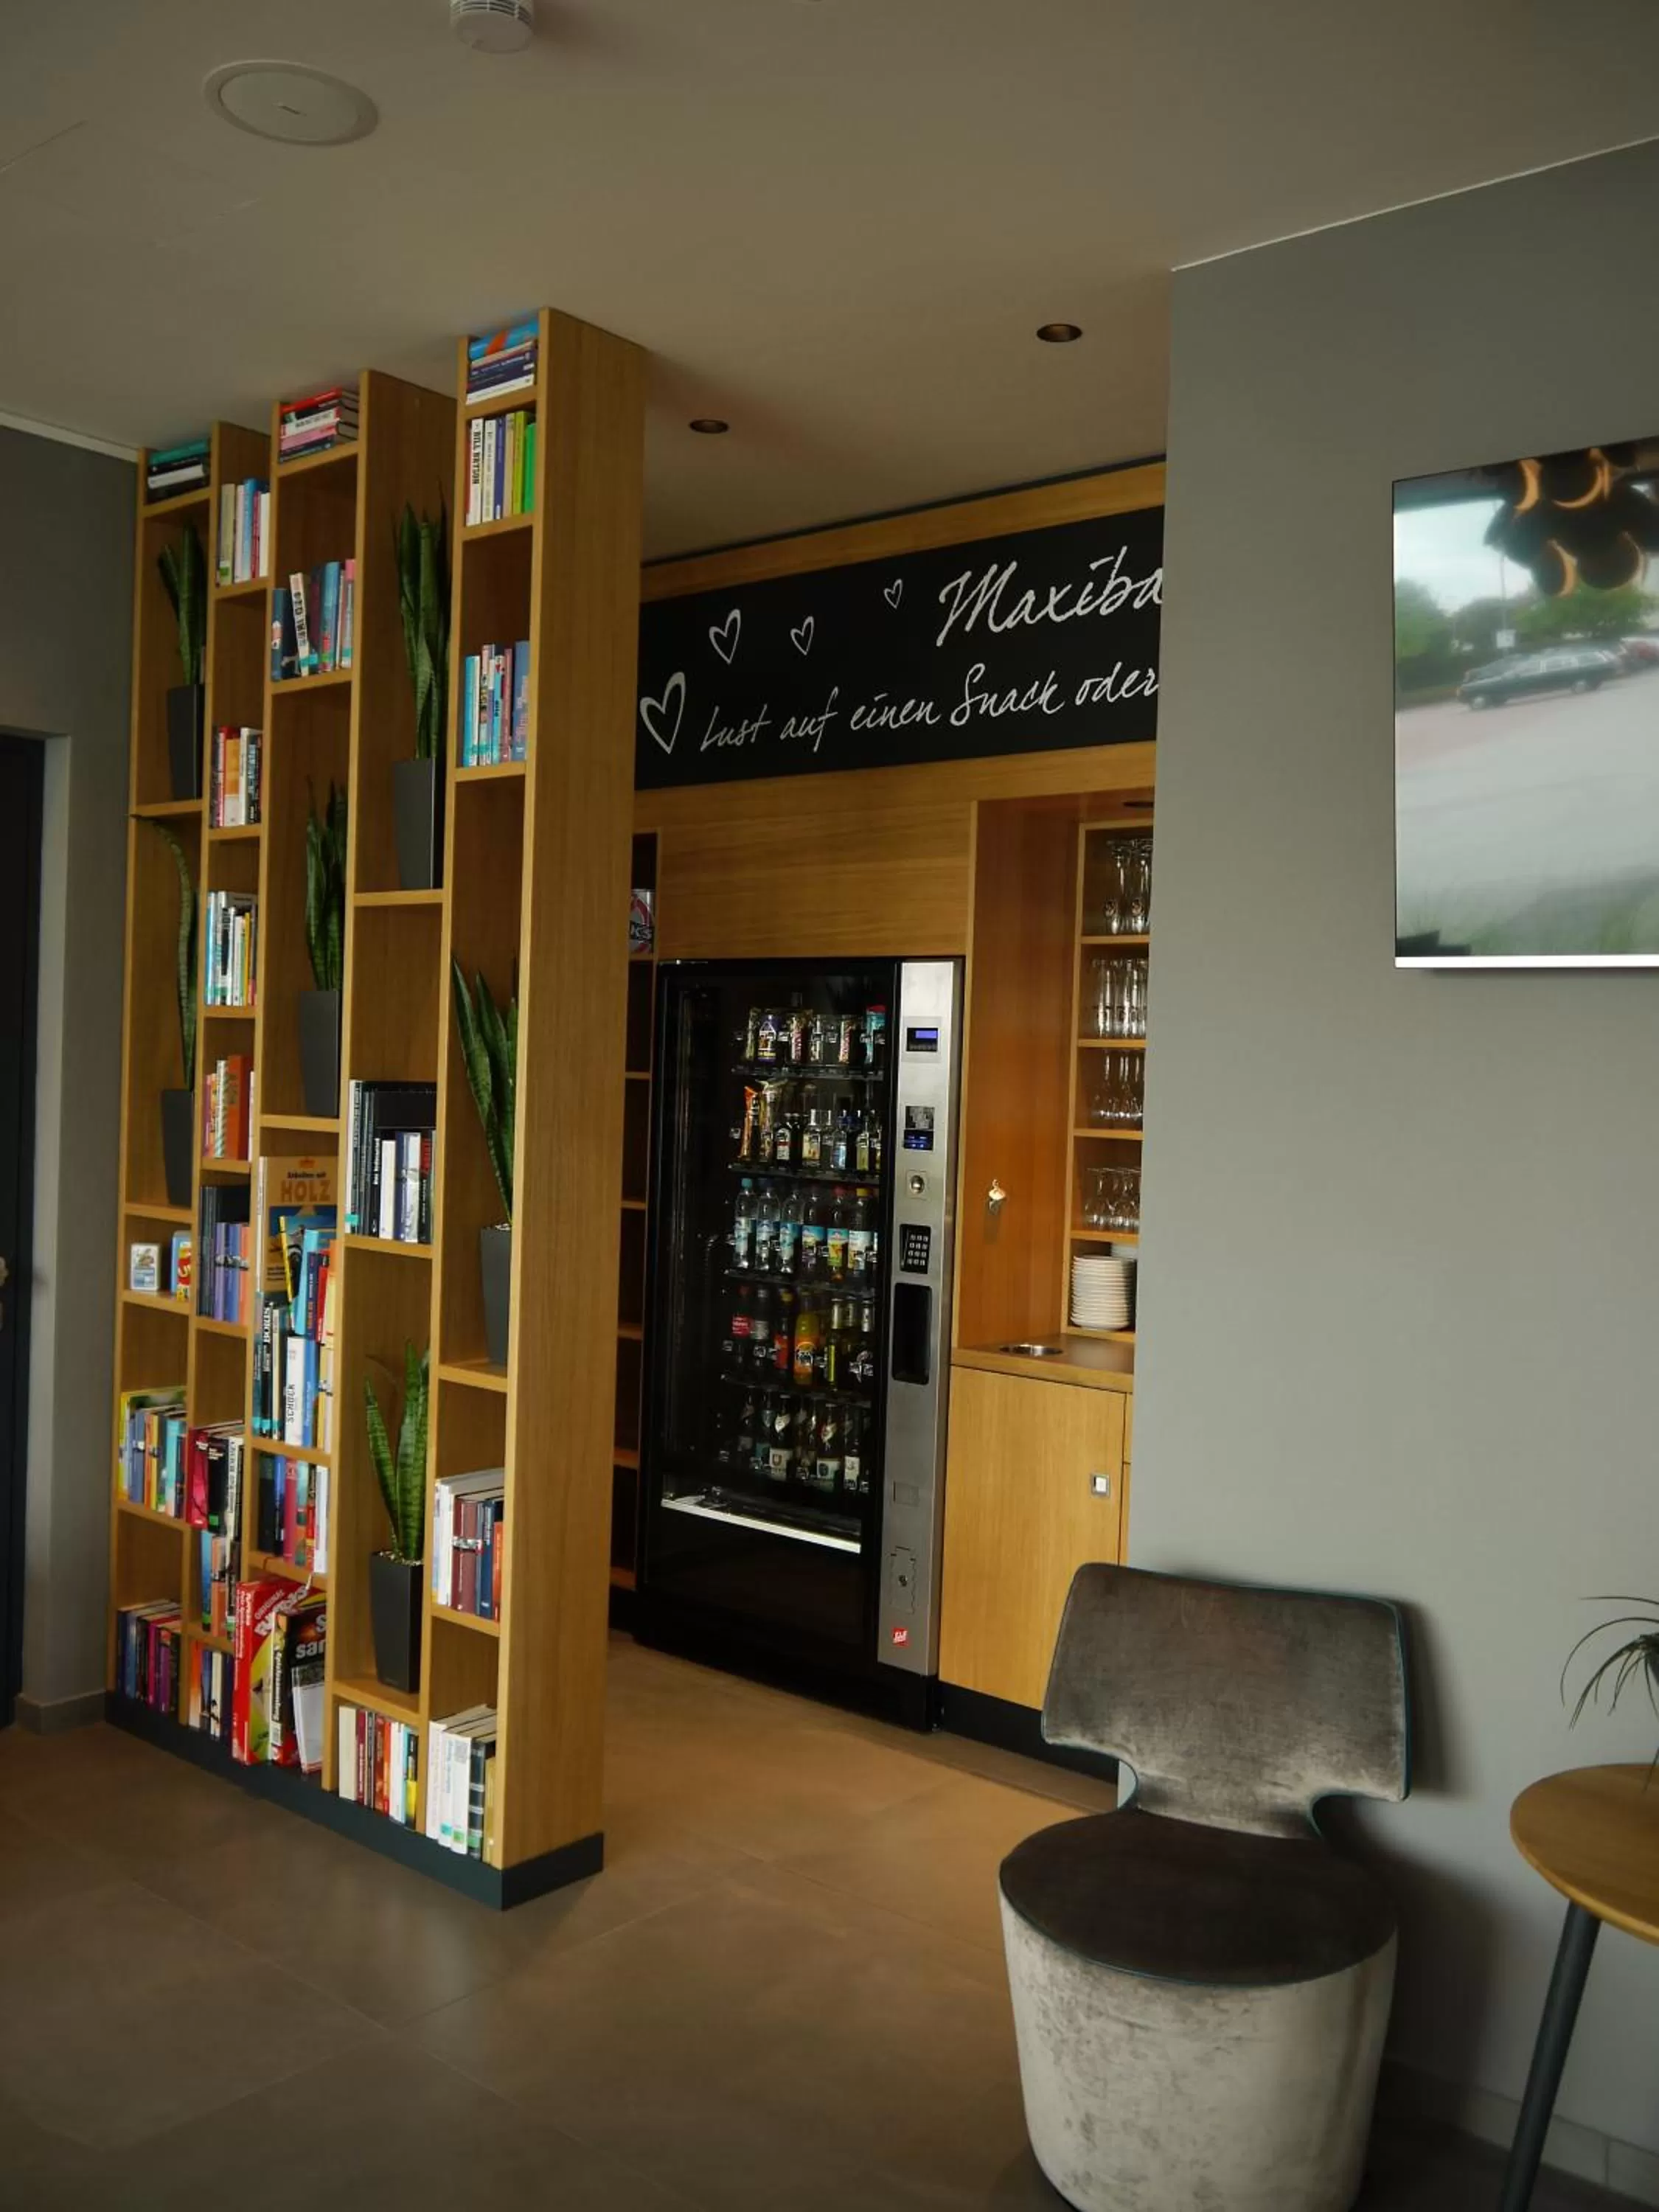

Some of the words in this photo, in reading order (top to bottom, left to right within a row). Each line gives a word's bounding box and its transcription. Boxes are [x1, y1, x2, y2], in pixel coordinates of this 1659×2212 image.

[699, 703, 771, 751] Lust
[779, 686, 838, 752] auf
[849, 692, 942, 731] einen
[950, 663, 1065, 726] Snack
[1074, 661, 1159, 706] oder
[280, 1180, 331, 1203] HOLZ
